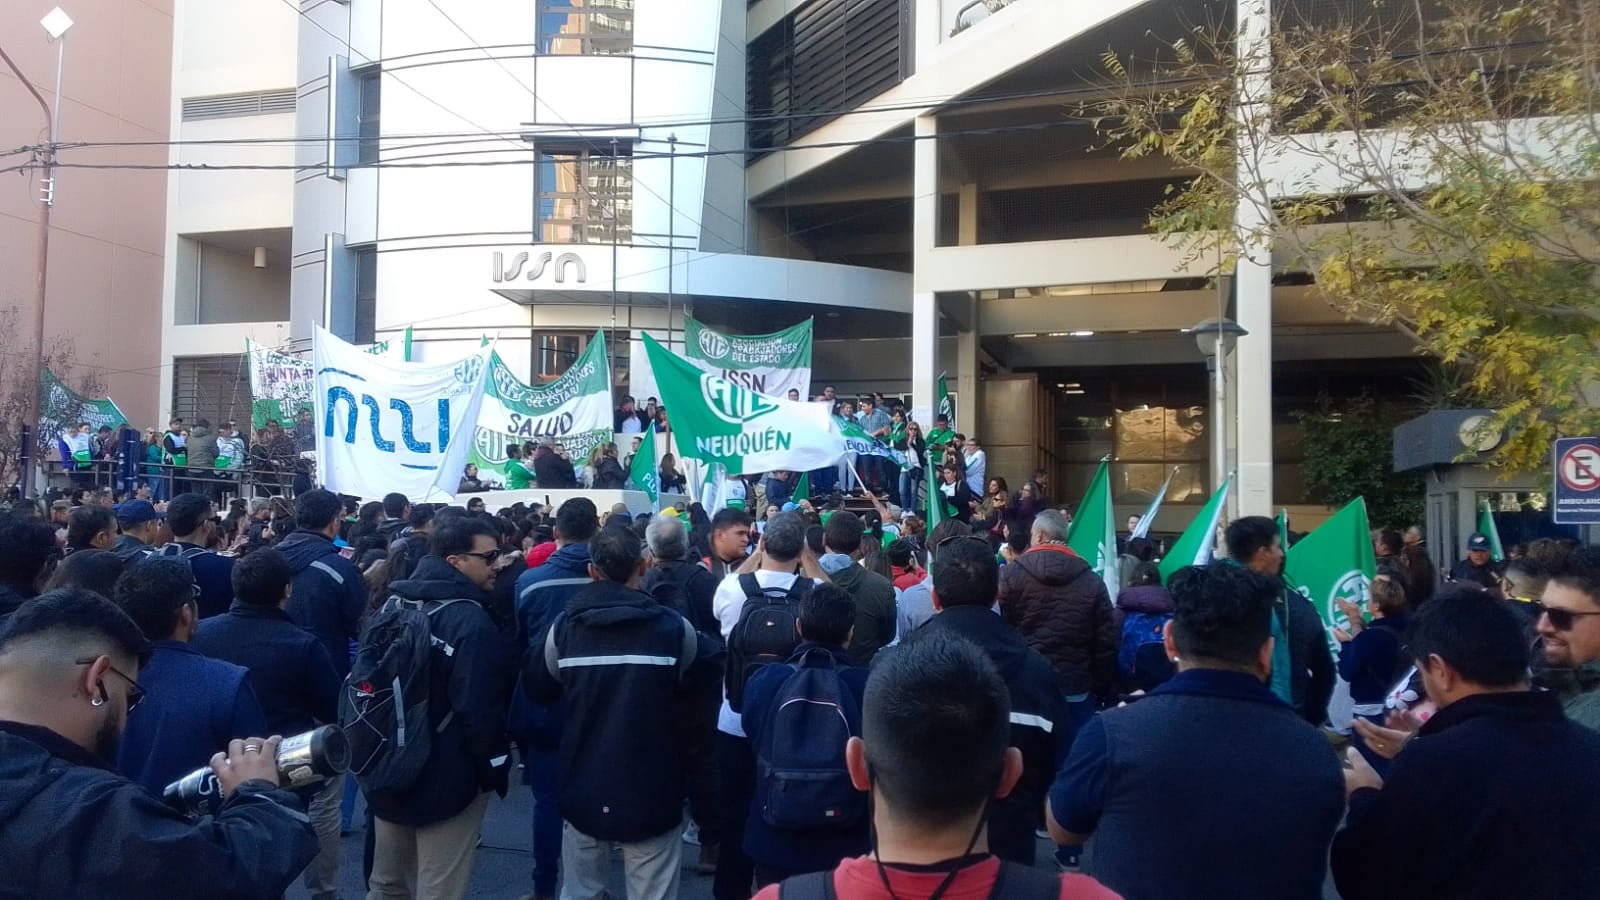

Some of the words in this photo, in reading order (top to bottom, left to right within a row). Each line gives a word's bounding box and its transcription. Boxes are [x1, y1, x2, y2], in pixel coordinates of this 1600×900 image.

[732, 352, 747, 363] DEL
[749, 354, 781, 364] ESTADO
[722, 369, 767, 393] ISSN
[525, 398, 545, 408] DEL
[507, 411, 574, 438] SALUD
[695, 426, 792, 458] NEUQUÉN
